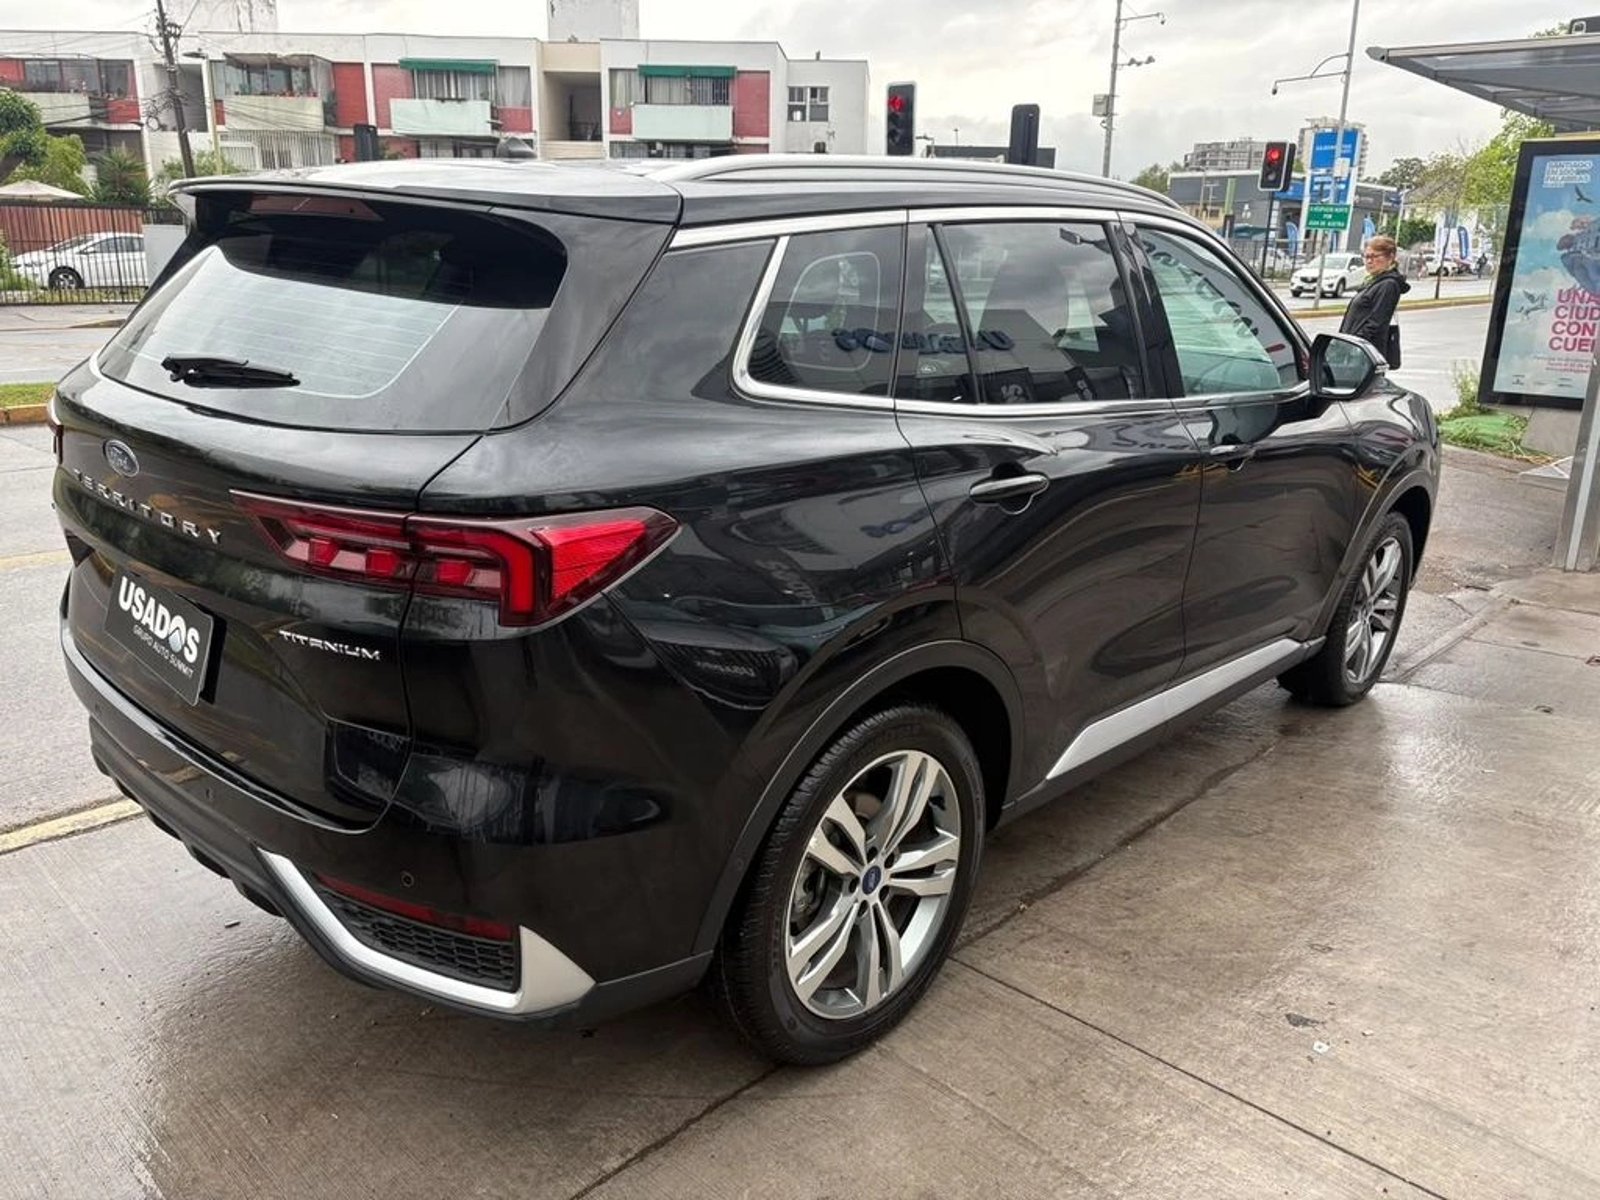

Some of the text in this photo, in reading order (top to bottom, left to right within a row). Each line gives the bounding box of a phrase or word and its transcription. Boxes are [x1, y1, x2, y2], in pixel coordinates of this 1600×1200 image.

[1551, 320, 1597, 336] CON
[73, 468, 222, 545] TERRITORY
[118, 576, 200, 663] USADOS
[278, 629, 381, 661] TITANIUM
[133, 624, 194, 679] GRUPO AUTO SUMMIT
